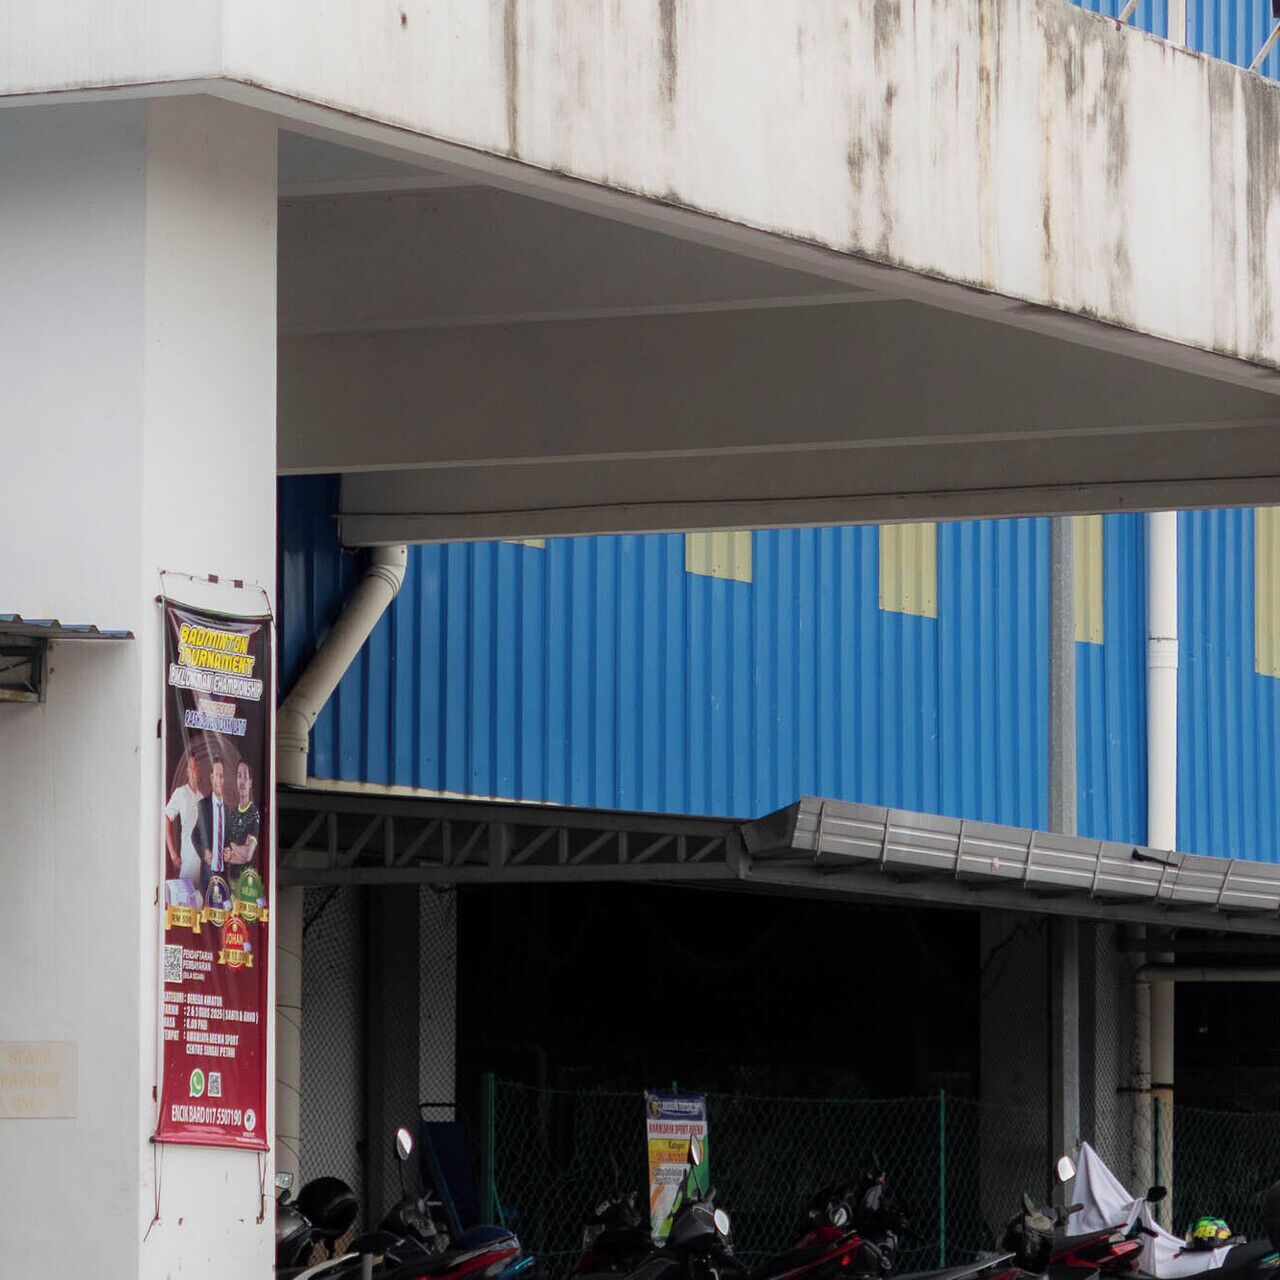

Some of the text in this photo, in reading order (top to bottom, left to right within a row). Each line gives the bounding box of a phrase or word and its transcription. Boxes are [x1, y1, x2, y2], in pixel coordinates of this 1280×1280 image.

[180, 623, 250, 655] BADMINTON
[178, 643, 255, 677] TOURNAMENT
[225, 933, 244, 944] JOHAN
[172, 1105, 188, 1121] ENCIK
